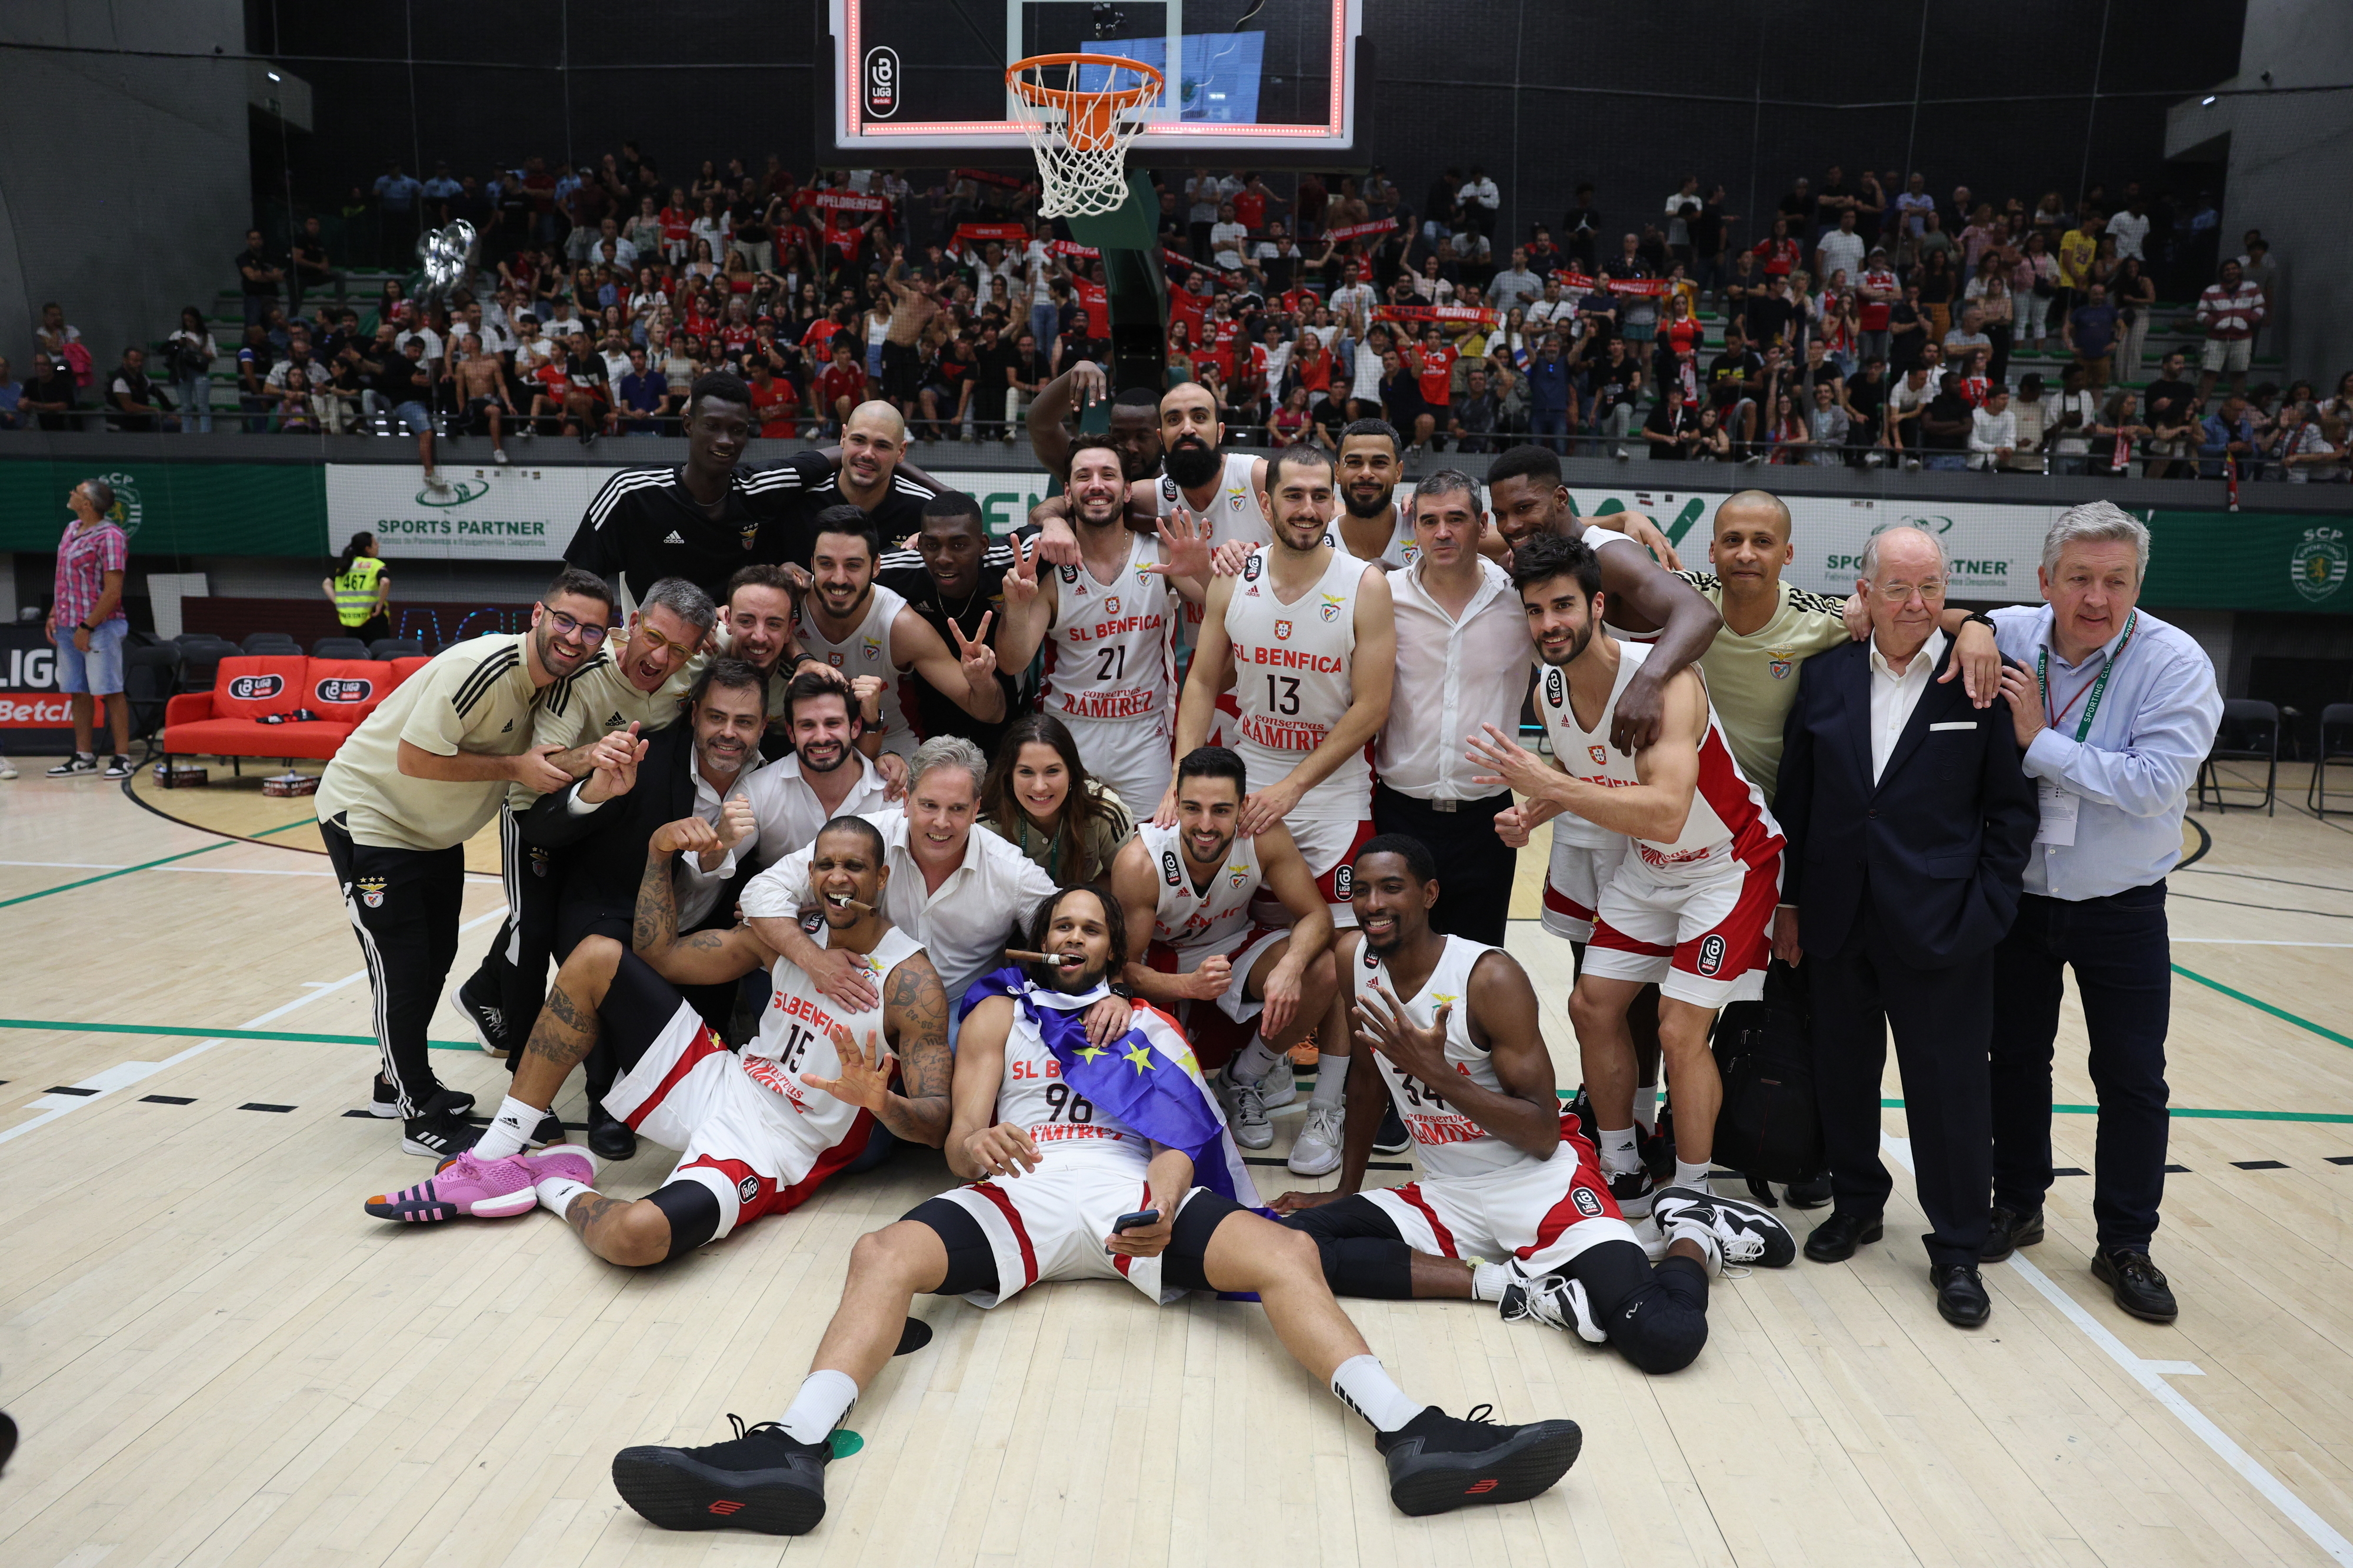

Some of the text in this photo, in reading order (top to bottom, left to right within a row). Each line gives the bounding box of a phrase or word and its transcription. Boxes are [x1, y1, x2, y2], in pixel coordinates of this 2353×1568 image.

[378, 520, 545, 535] SPORTS PARTNER
[2304, 527, 2344, 541] SCP
[344, 574, 366, 590] 467
[1069, 614, 1161, 641] SL BENFICA
[0, 649, 59, 688] IG
[1096, 645, 1125, 680] 21
[1233, 643, 1342, 673] SL BENFICA
[1061, 690, 1154, 718] RAMIREZ
[1083, 686, 1141, 699] conservas
[1267, 674, 1301, 715] 13
[2084, 683, 2104, 723] SPORTING
[0, 700, 74, 722] Betcl
[1255, 714, 1324, 730] conservas
[1242, 715, 1329, 750] RAMIRE
[774, 991, 845, 1039] SL BENFI
[779, 1023, 814, 1073] 15
[1012, 1060, 1038, 1080] SL
[1046, 1083, 1093, 1123] 96
[499, 1118, 520, 1130] adidas
[1407, 1112, 1469, 1124] conserva
[1404, 1119, 1486, 1146] RAMIRE
